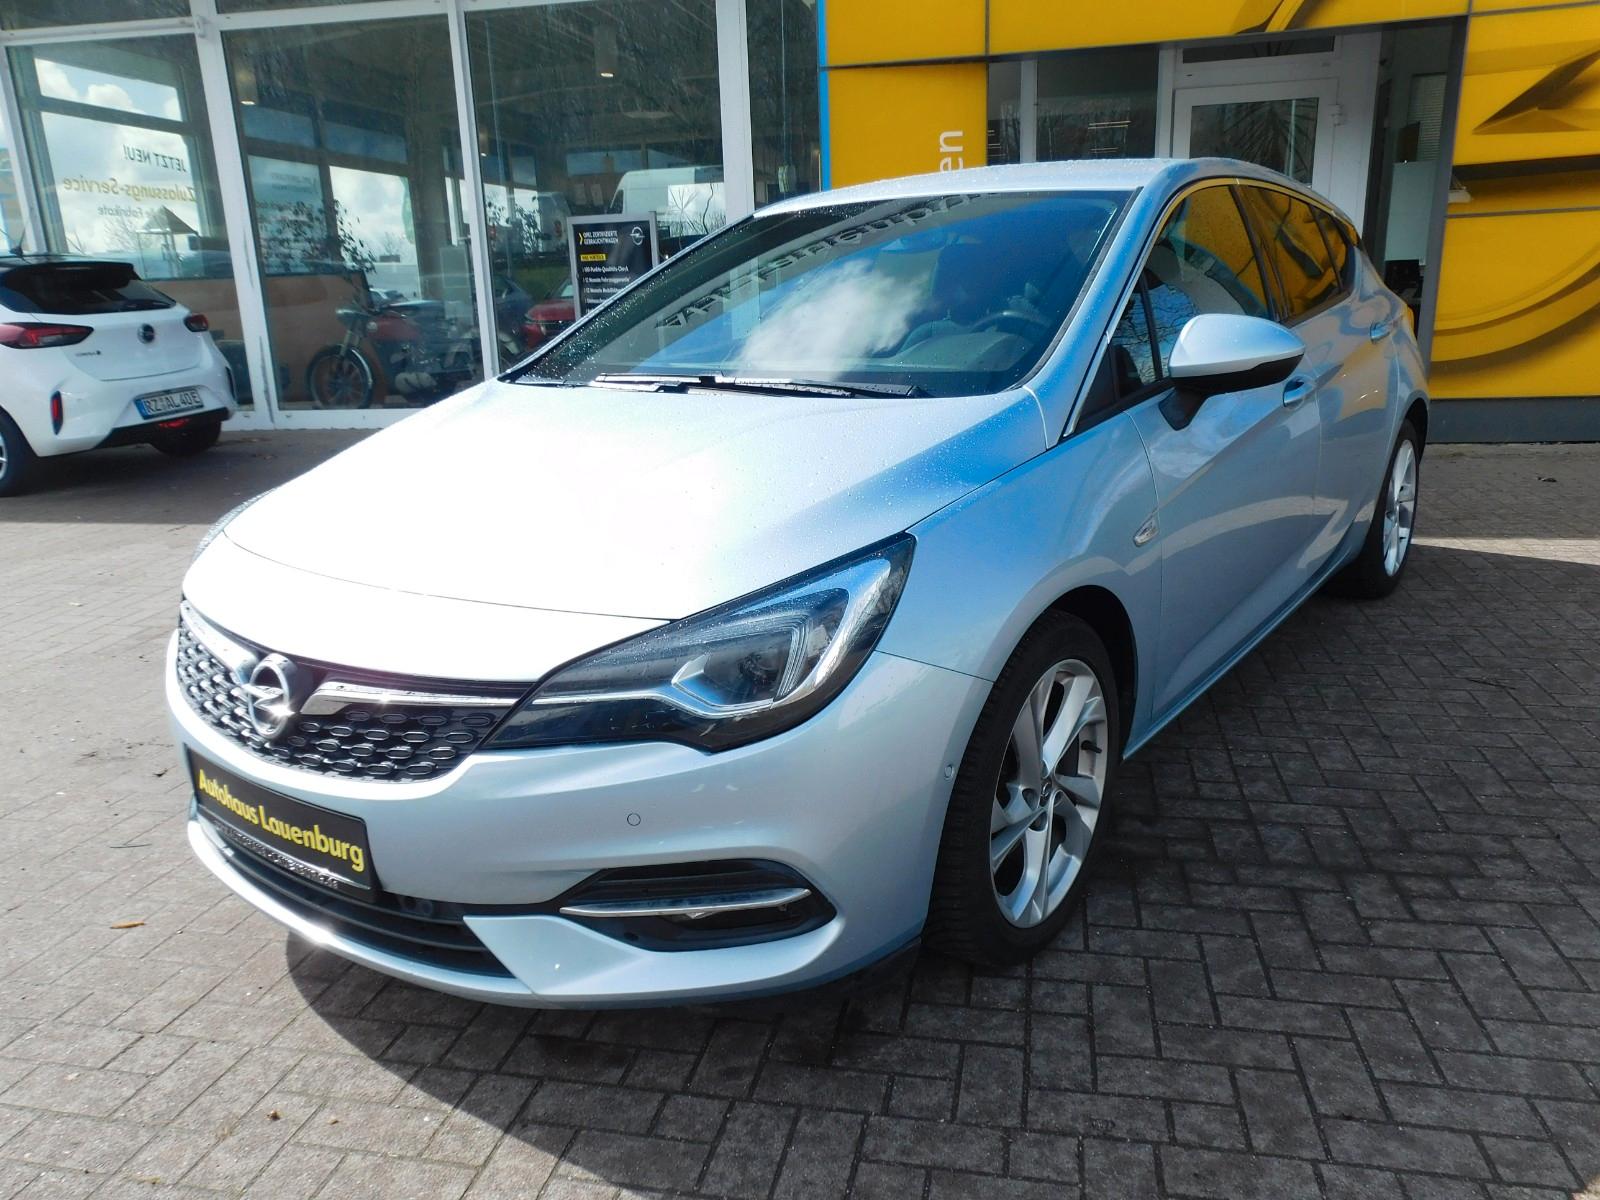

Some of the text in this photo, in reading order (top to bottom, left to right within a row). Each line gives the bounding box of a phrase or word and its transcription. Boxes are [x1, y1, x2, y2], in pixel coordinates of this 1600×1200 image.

[145, 398, 162, 414] RZ
[166, 395, 180, 409] AL
[199, 769, 258, 825] Autohaus
[259, 805, 365, 872] Lauenburg
